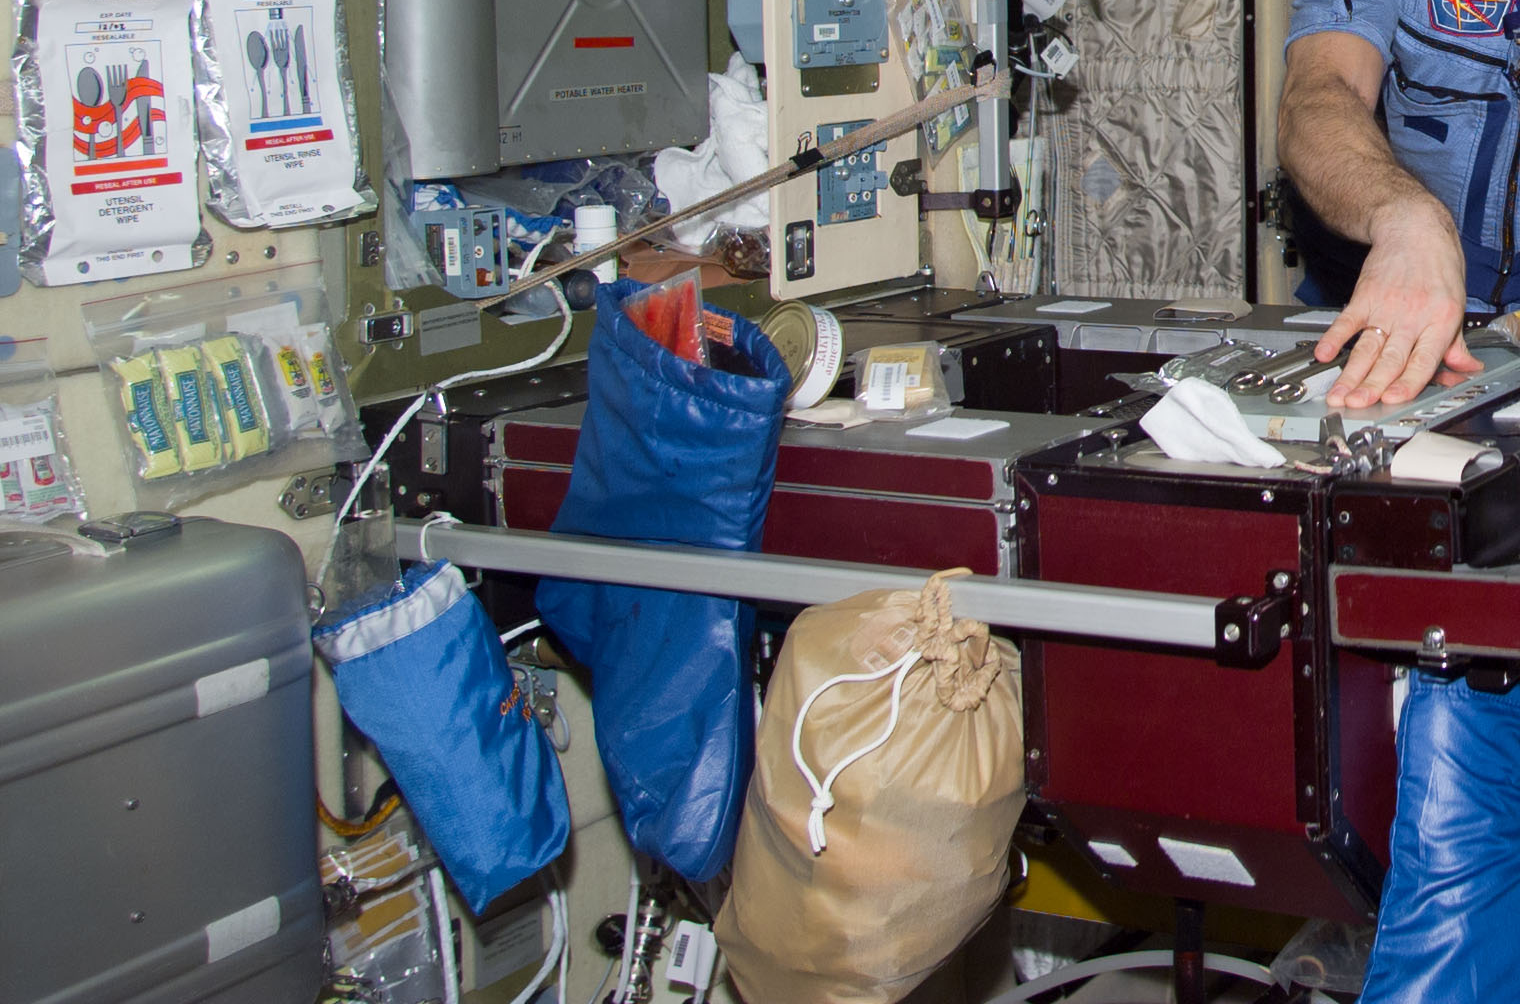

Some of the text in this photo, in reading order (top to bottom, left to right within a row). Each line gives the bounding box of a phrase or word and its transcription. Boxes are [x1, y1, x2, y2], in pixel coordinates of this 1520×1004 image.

[555, 83, 644, 101] POTABLE WATER HEATER
[264, 148, 321, 163] UTENSIL RINSE
[284, 159, 305, 169] WIPE
[94, 177, 157, 191] RESEAL AFTER USE
[105, 195, 145, 207] UTENSIL
[98, 203, 155, 217] DETERGENT
[116, 214, 139, 225] WIPE
[112, 253, 126, 261] END
[227, 363, 254, 424] MAYONNAISE
[182, 377, 200, 438] MAYONNAISE
[136, 386, 163, 448] MAYONNAISE
